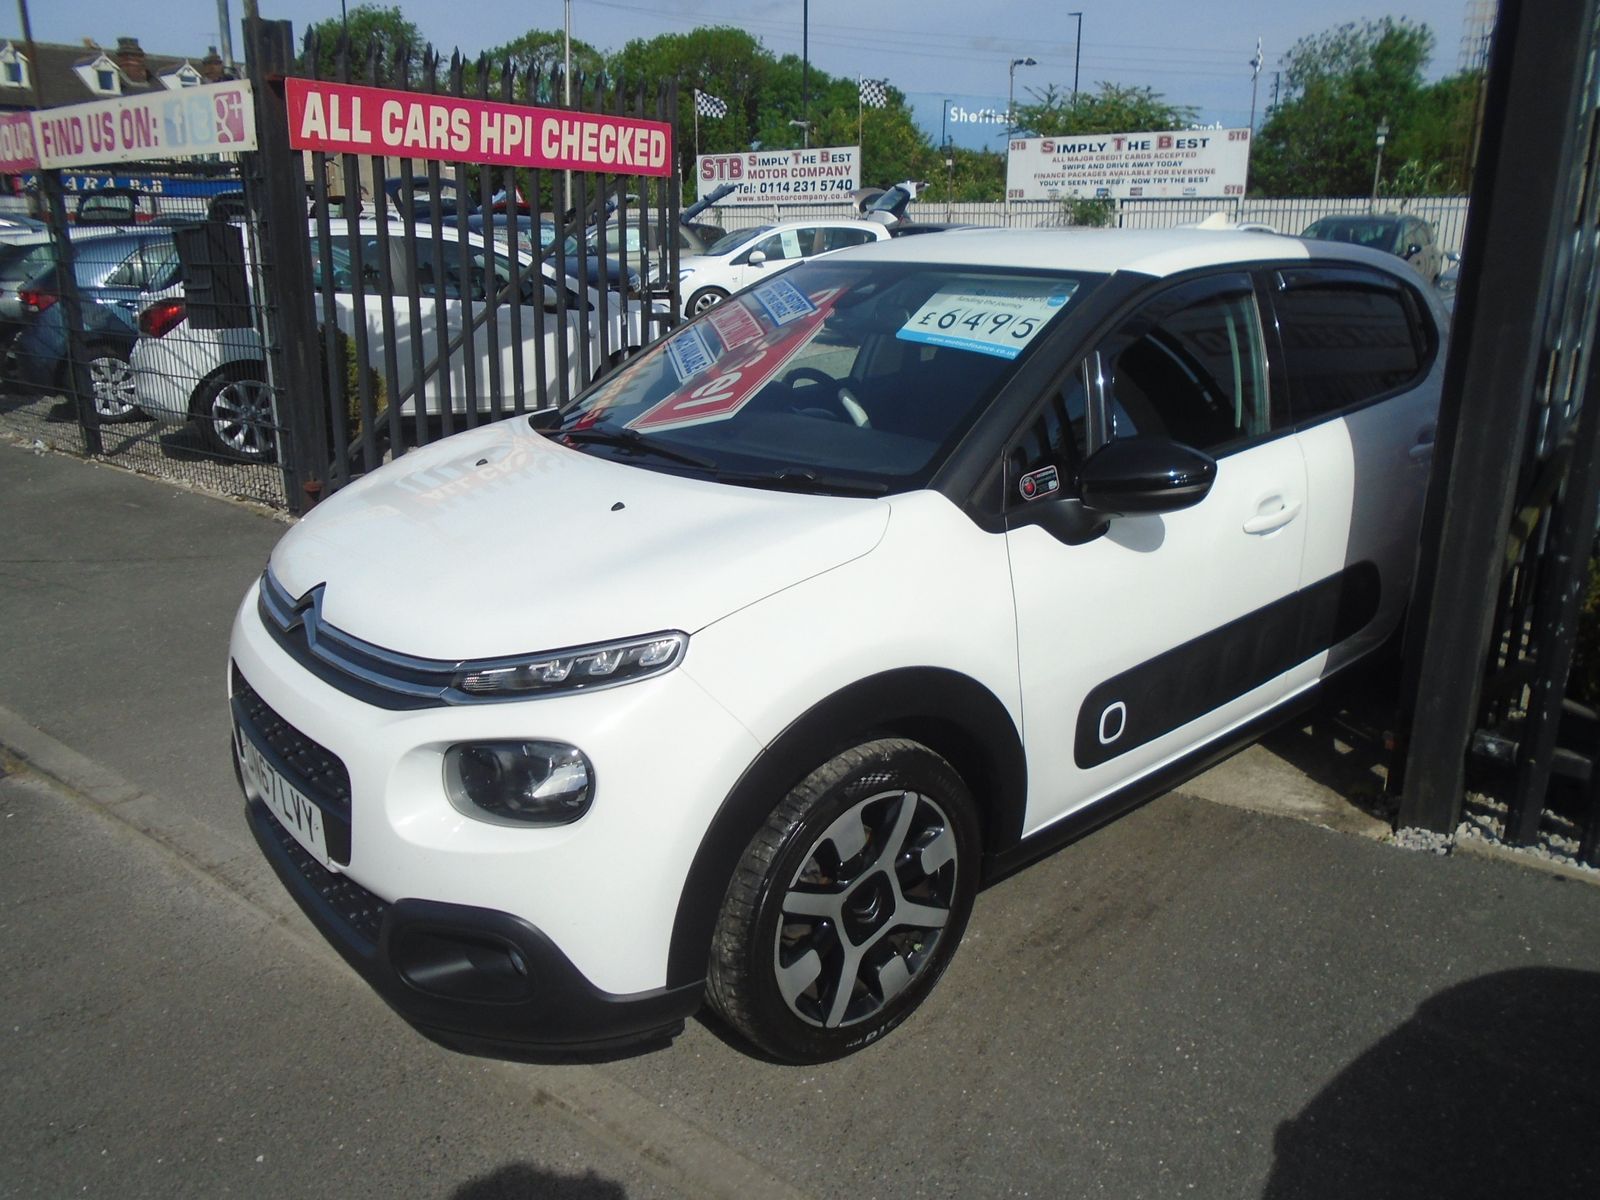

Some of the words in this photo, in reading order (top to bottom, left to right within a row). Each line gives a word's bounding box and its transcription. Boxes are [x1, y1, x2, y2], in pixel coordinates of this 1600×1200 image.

[41, 115, 84, 157] FIND
[88, 111, 115, 151] US
[120, 107, 160, 149] ON:
[301, 92, 371, 144] ALL
[381, 100, 470, 152] CARS
[480, 111, 533, 157] HPI
[541, 118, 666, 168] CHECKED
[1228, 131, 1248, 141] STB
[1010, 141, 1027, 150] STB
[1041, 140, 1107, 154] SIMPLY
[1112, 137, 1150, 151] THE
[1157, 135, 1210, 150] BEST
[748, 155, 789, 167] SIMPLY
[792, 152, 816, 165] THE
[820, 151, 852, 164] BEST
[701, 156, 744, 181] STB
[747, 168, 788, 180] MOTOR
[791, 166, 851, 179] COMPANY
[1109, 169, 1152, 177] AVAILABLE
[738, 183, 756, 194] Tel:
[760, 181, 790, 194] 0114
[793, 180, 816, 192] 231
[820, 179, 853, 191] 5740
[1008, 189, 1024, 199] STB
[1224, 185, 1243, 195] STB
[279, 777, 315, 843] LVY
